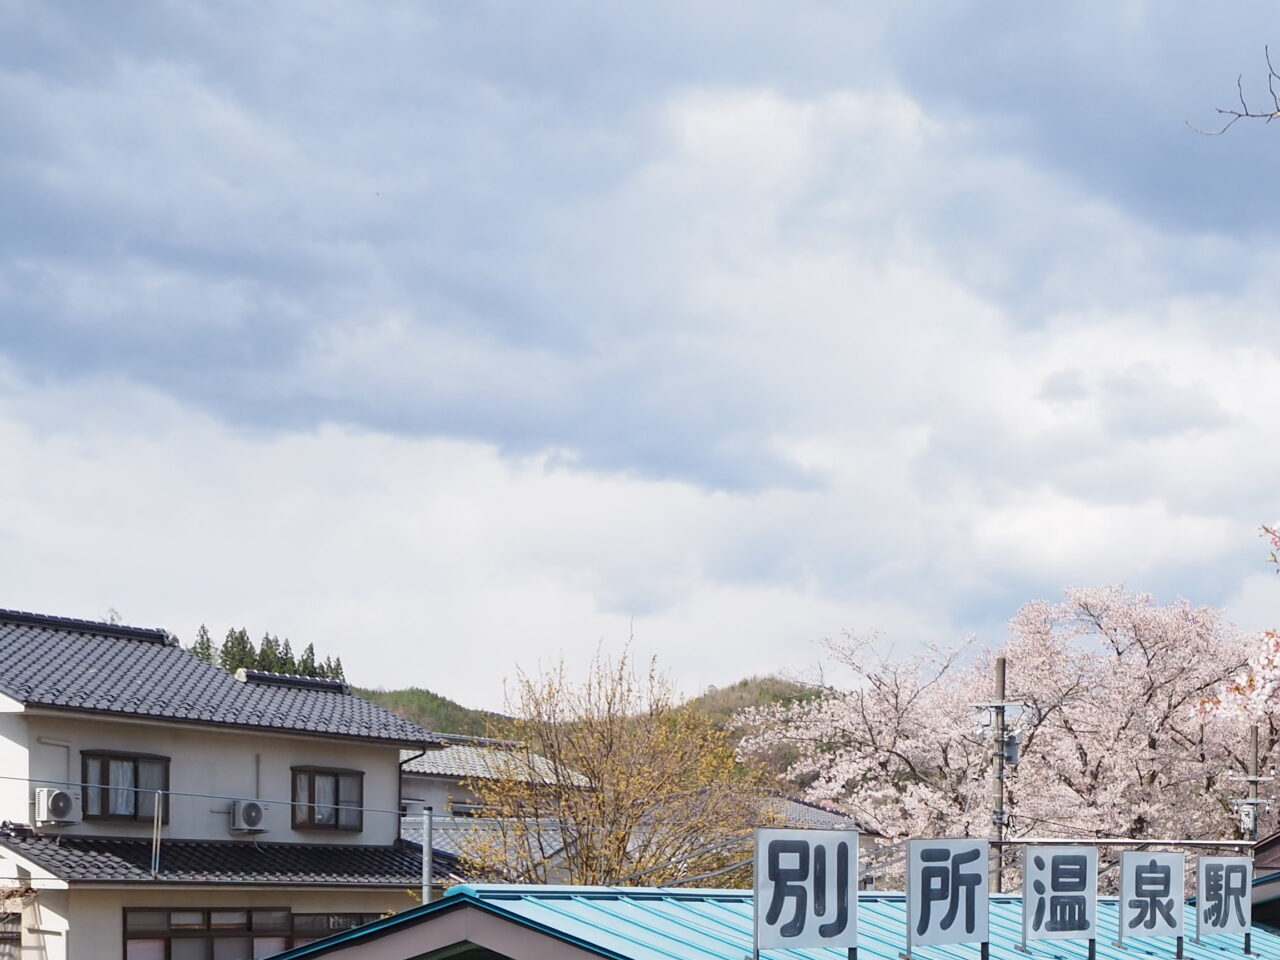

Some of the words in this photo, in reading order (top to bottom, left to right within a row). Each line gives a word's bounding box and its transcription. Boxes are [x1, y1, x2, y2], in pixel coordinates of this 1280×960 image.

[766, 839, 1247, 938] 別所温泉駅
